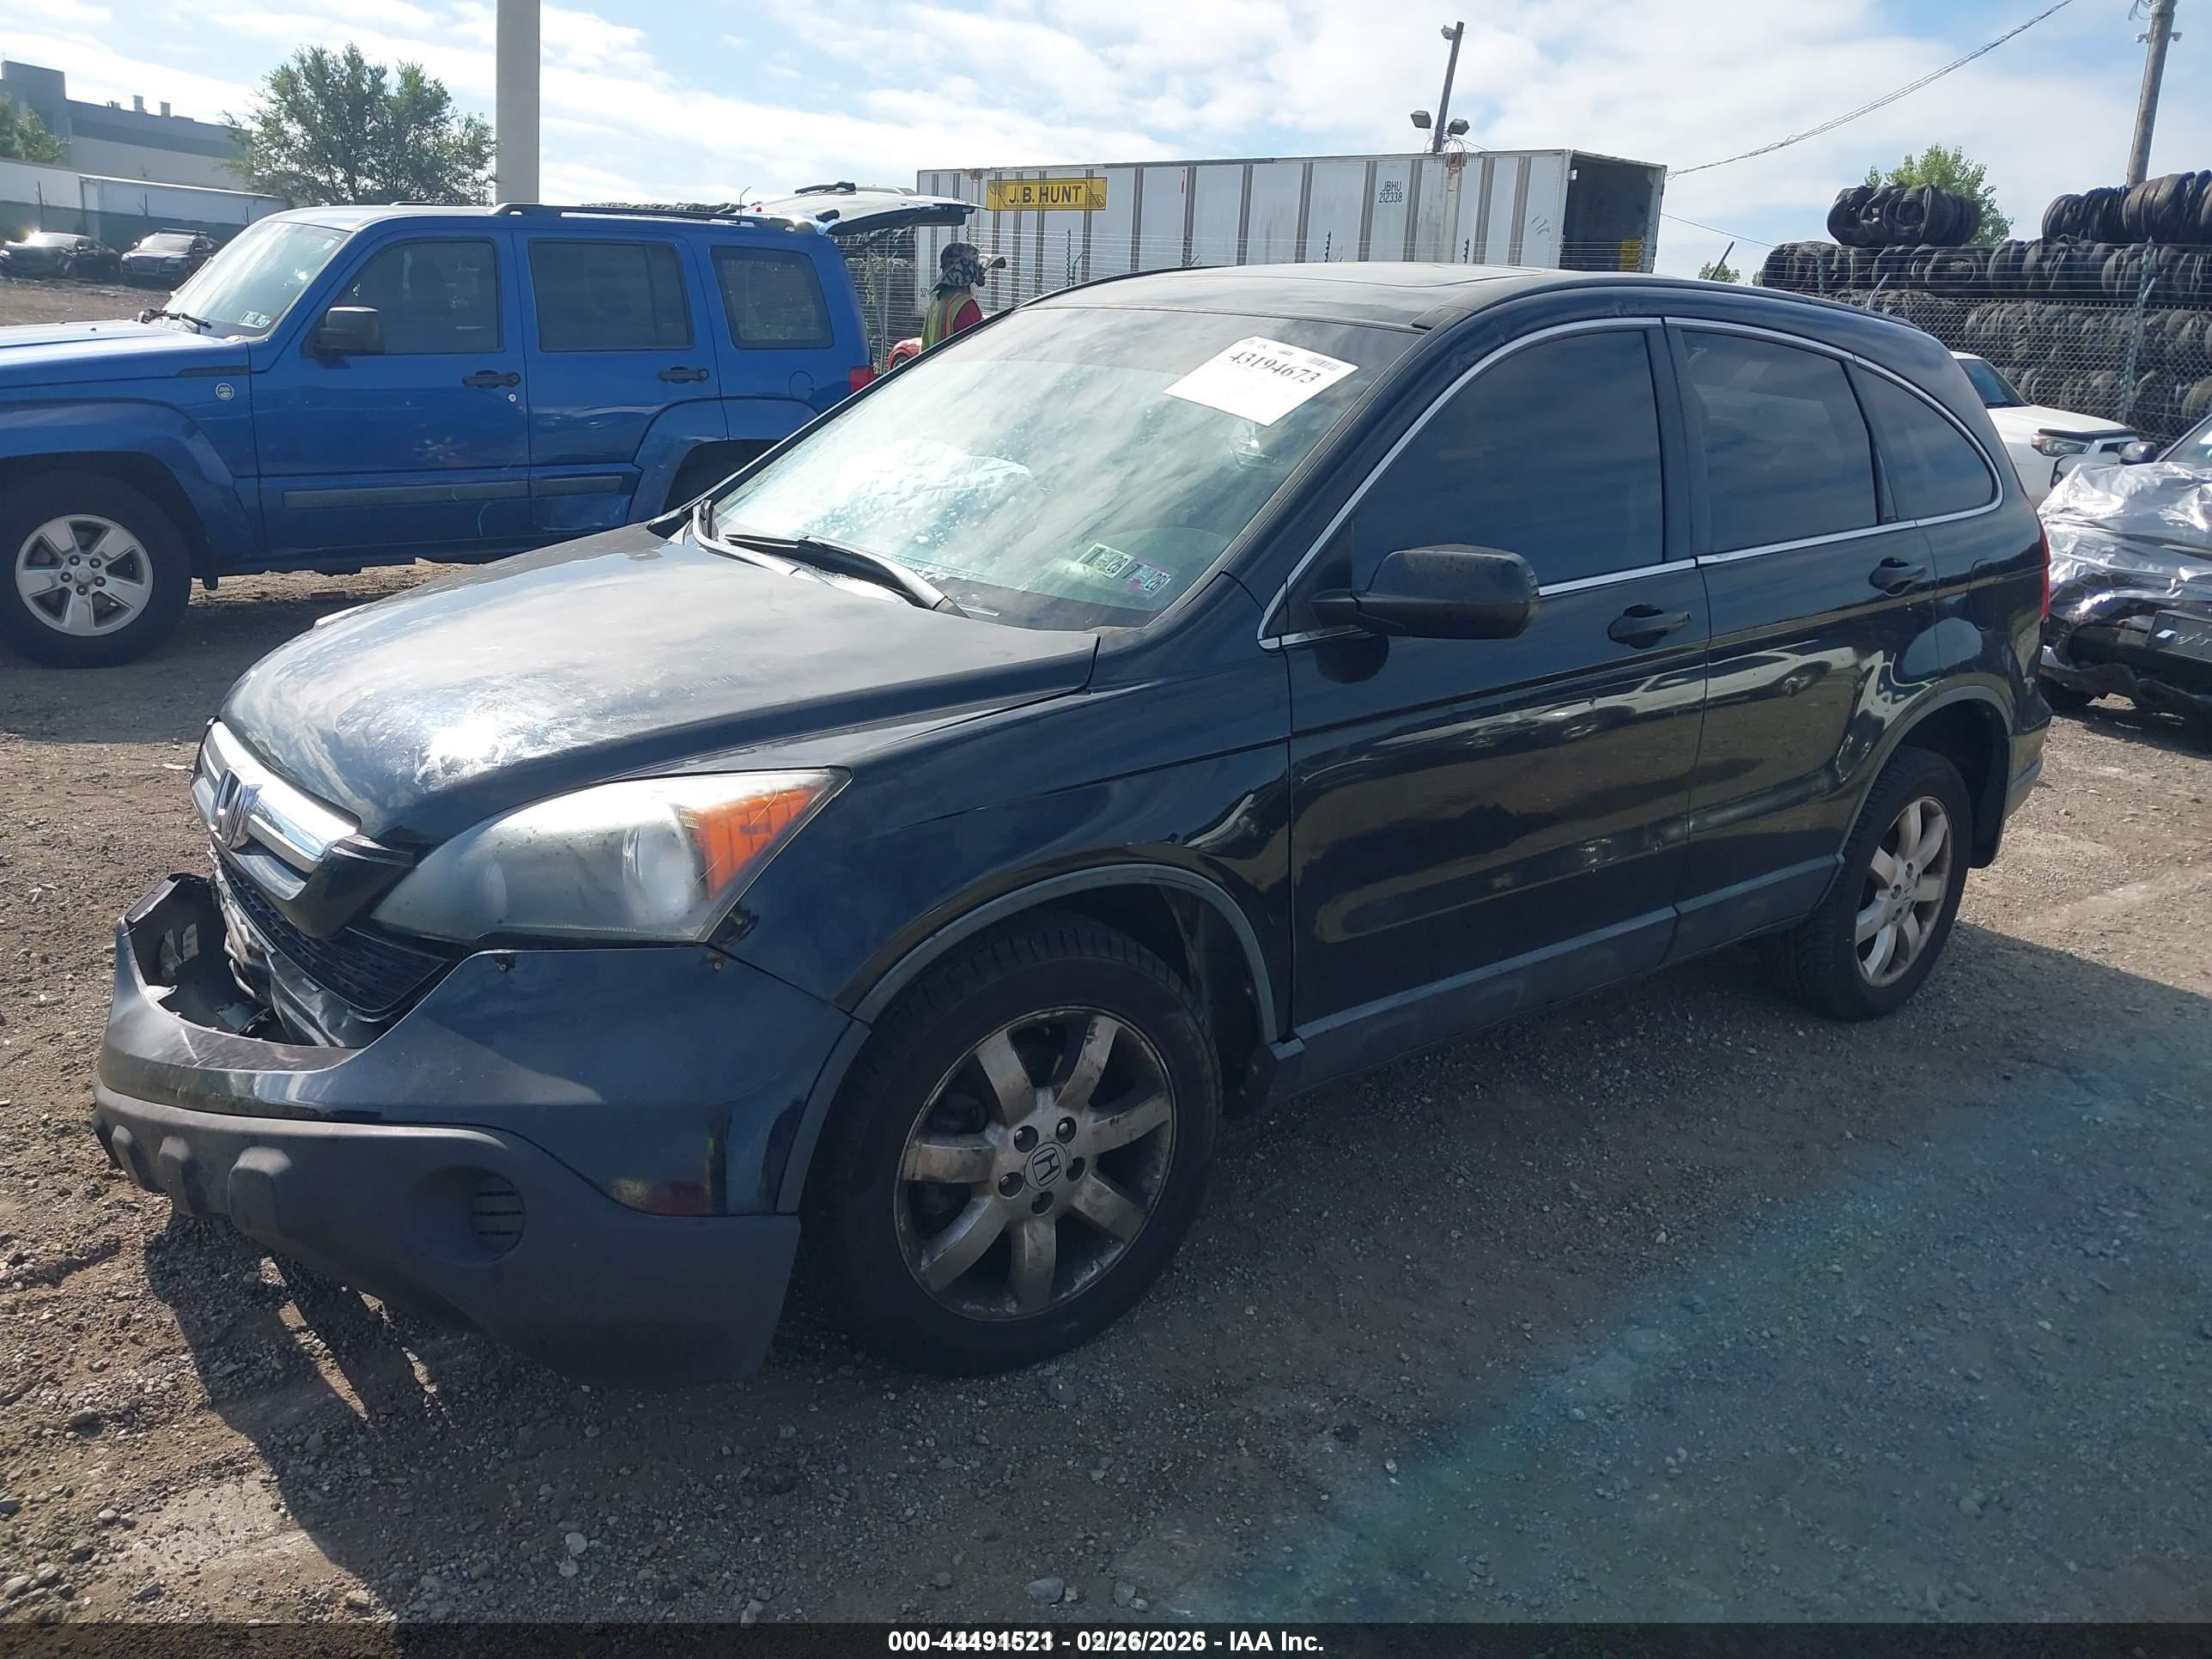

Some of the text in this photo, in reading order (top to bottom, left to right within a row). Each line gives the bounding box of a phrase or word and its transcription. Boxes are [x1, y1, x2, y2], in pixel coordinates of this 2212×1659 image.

[1382, 180, 1402, 191] JBHU
[1008, 185, 1082, 204] J.B. HUNT
[1378, 191, 1403, 204] 212338
[1230, 351, 1322, 384] 43194673
